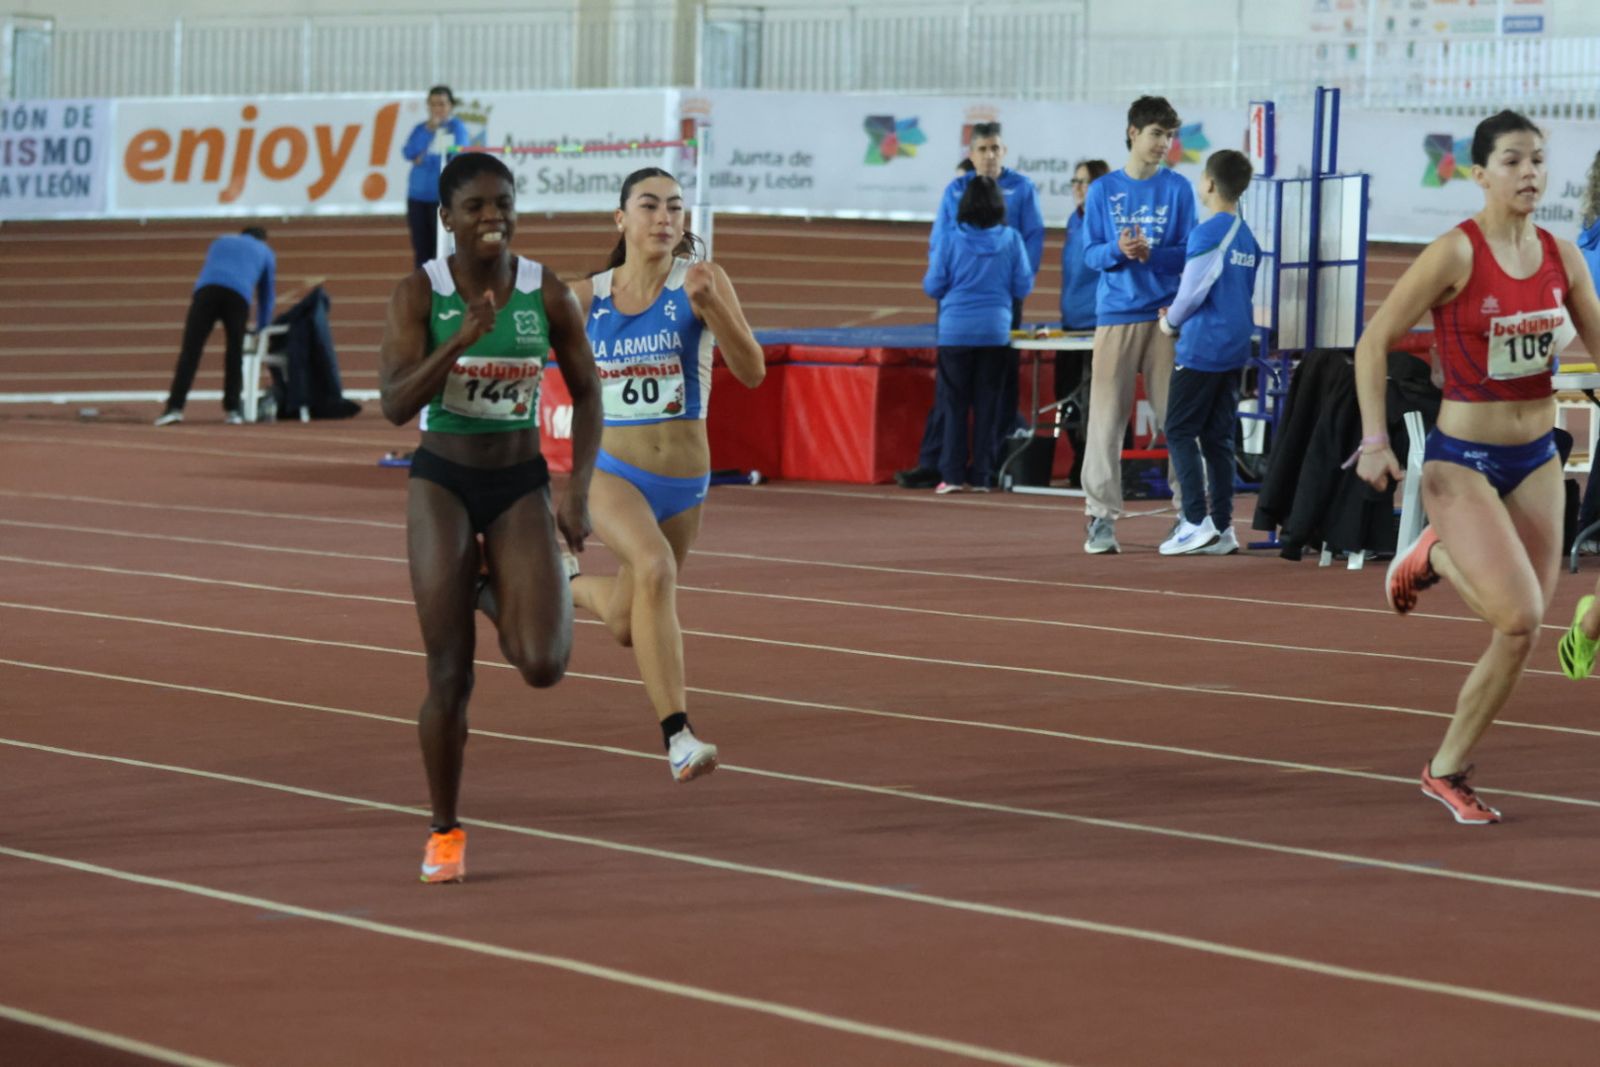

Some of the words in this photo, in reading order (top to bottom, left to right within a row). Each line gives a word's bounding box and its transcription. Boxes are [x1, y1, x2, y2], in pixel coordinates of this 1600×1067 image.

[63, 104, 93, 129] DE
[123, 102, 400, 204] enjoy!
[729, 149, 783, 167] Junta
[788, 151, 813, 168] de
[1016, 154, 1069, 174] Junta
[17, 174, 30, 197] Y
[35, 170, 91, 198] LEÓN
[536, 167, 624, 196] Salama
[677, 170, 744, 188] Catilla
[748, 173, 759, 193] y
[764, 172, 814, 189] León
[1533, 205, 1574, 222] stilla
[592, 339, 608, 358] LA
[612, 328, 683, 358] ARMUÑA
[1504, 331, 1554, 363] 108
[596, 362, 681, 379] bedunia
[464, 378, 520, 404] 144
[621, 377, 660, 405] 60
